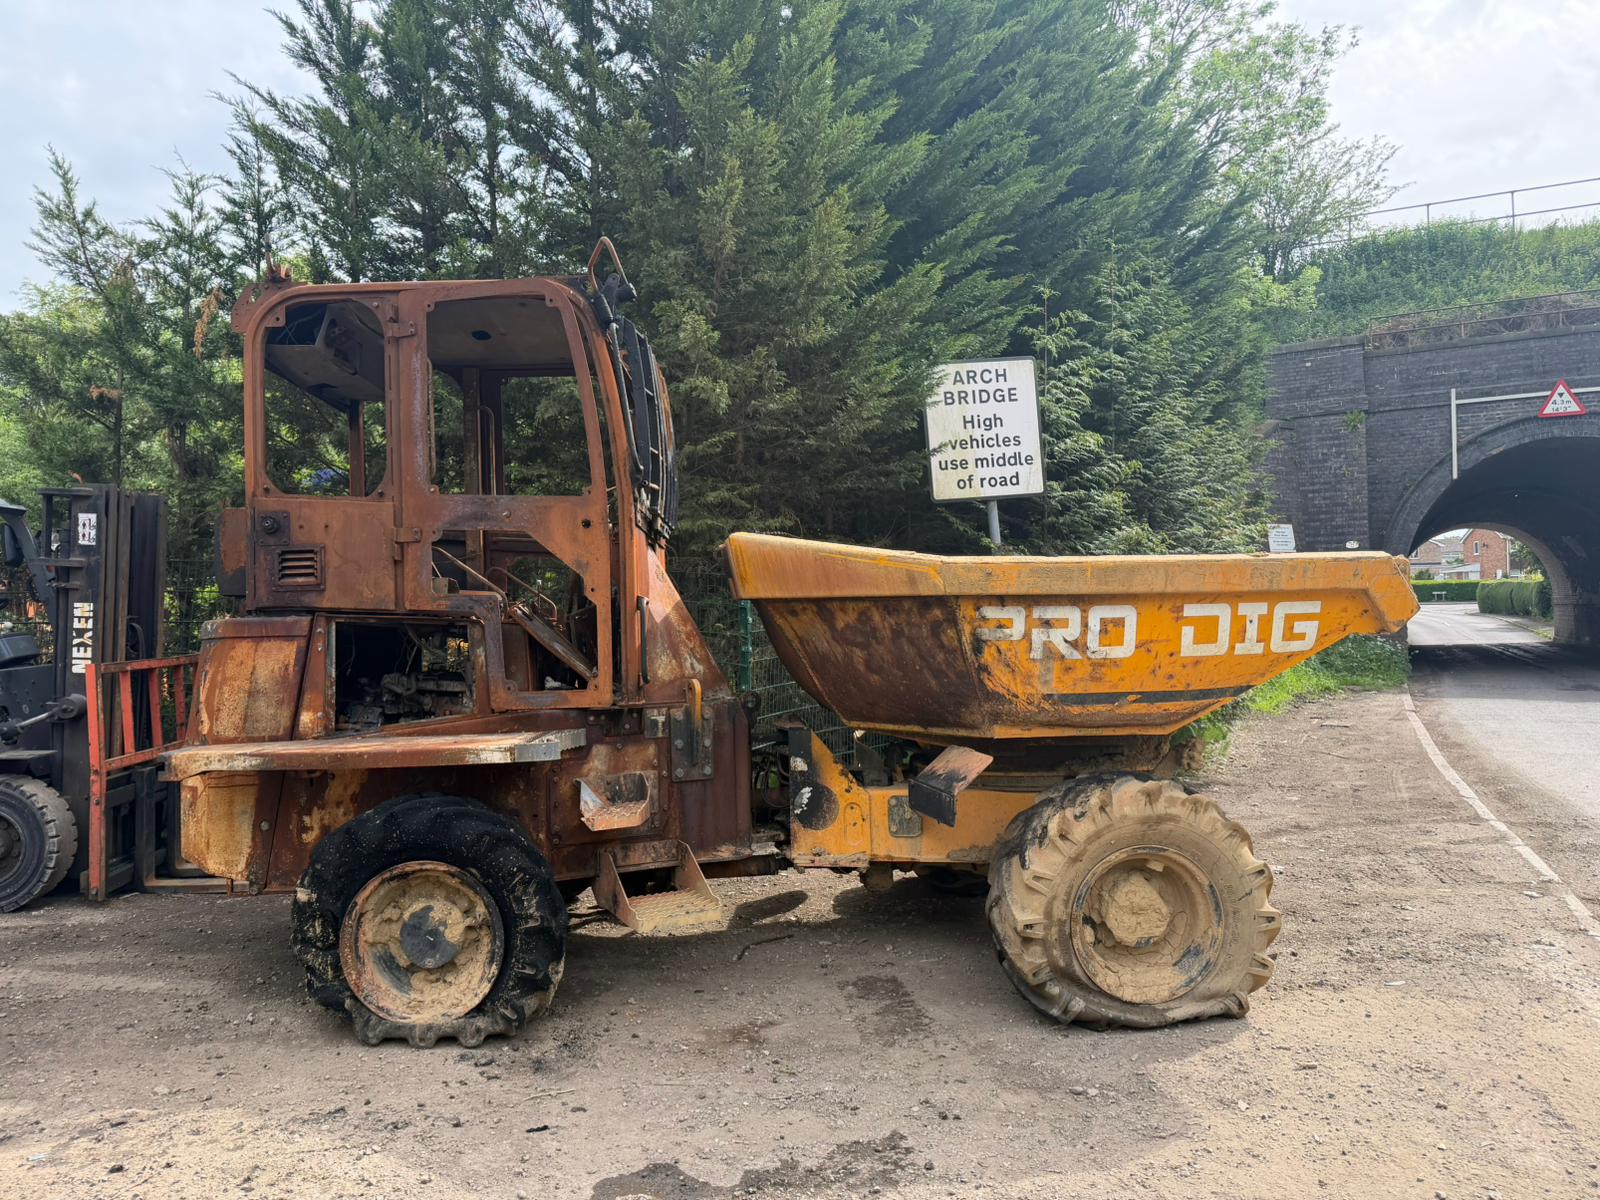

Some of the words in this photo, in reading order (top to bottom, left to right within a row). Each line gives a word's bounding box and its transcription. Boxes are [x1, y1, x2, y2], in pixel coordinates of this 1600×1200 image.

[952, 368, 1008, 386] ARCH
[943, 387, 1019, 406] BRIDGE
[962, 413, 1004, 431] High
[949, 433, 1022, 450] vehicles
[938, 458, 969, 471] use
[975, 451, 1034, 469] middle
[956, 474, 975, 490] of
[979, 471, 1020, 489] road
[71, 602, 94, 674] NEXEN
[974, 604, 1138, 660] PRO
[1180, 600, 1322, 657] DIG
